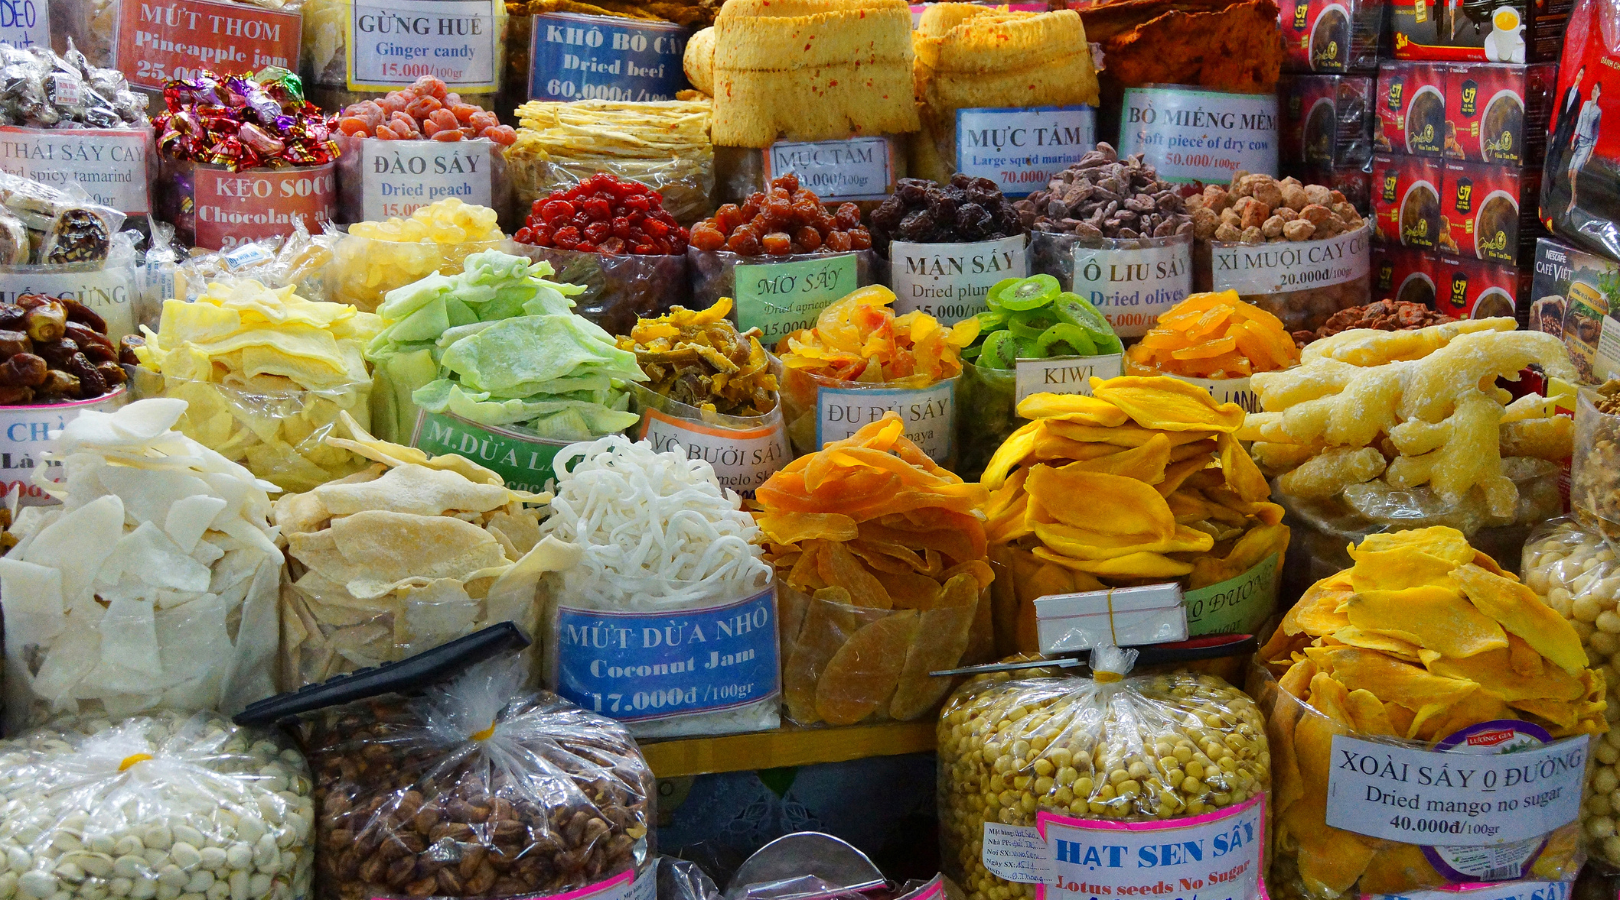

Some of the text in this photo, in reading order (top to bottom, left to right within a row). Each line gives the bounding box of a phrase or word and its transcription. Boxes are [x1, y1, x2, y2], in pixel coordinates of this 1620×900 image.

[140, 3, 282, 42] MỨT THƠM
[358, 11, 430, 35] GỪNG
[135, 30, 288, 68] Pineapple jam
[546, 25, 604, 48] KHÔ
[612, 31, 648, 52] BÒ
[376, 42, 476, 60] Ginger candy
[381, 62, 463, 79] 15.000/100gr
[564, 54, 665, 79] Dried beef
[1129, 101, 1157, 124] BÒ
[967, 125, 1027, 152] MỰC
[1136, 131, 1269, 153] Soft piece of dry cow
[111, 146, 144, 162] CAY
[374, 150, 426, 174] ĐÀO
[973, 153, 1083, 168] Large squid marinat
[1165, 152, 1241, 170] 50.000/100gr
[30, 169, 68, 184] spicy
[74, 169, 132, 182] tamarind
[800, 172, 868, 187] 0.000/100gr
[1001, 170, 1052, 184] 70.000/
[92, 193, 116, 207] 0gr
[216, 177, 272, 202] KẸO
[381, 182, 472, 199] Dried peach
[1457, 185, 1471, 202] G7
[199, 205, 308, 225] Chocolate
[1218, 250, 1239, 270] XÍ
[1244, 247, 1302, 269] MUỘI
[1308, 242, 1346, 263] CAY
[905, 254, 965, 281] MẬN
[1083, 258, 1101, 281] Ô
[1109, 263, 1149, 282] LIU
[757, 275, 797, 296] MƠ
[912, 284, 953, 298] Dried
[1452, 279, 1466, 296] G7
[1090, 288, 1184, 307] Dried olives
[763, 303, 793, 316] Dried
[763, 317, 817, 336] 15.000/
[1044, 365, 1094, 384] KIWI
[828, 404, 861, 424] ĐU
[687, 443, 747, 466] BƯỞI
[718, 473, 751, 486] melo
[567, 601, 768, 649] MỨT DỪA NHỎ
[590, 648, 755, 679] Coconut Jam
[703, 680, 754, 702] /100gr
[1340, 750, 1408, 782] XOÀI
[1418, 765, 1477, 788] SẤY
[1504, 748, 1582, 787] ĐƯỜNG
[1366, 785, 1563, 817] Dried mango no sugar
[1055, 817, 1257, 871] HẠT SEN SẤY
[1055, 874, 1112, 895] Lotus
[1117, 881, 1173, 896] seeds
[1179, 877, 1203, 892] No
[1208, 859, 1251, 886] Sugar
